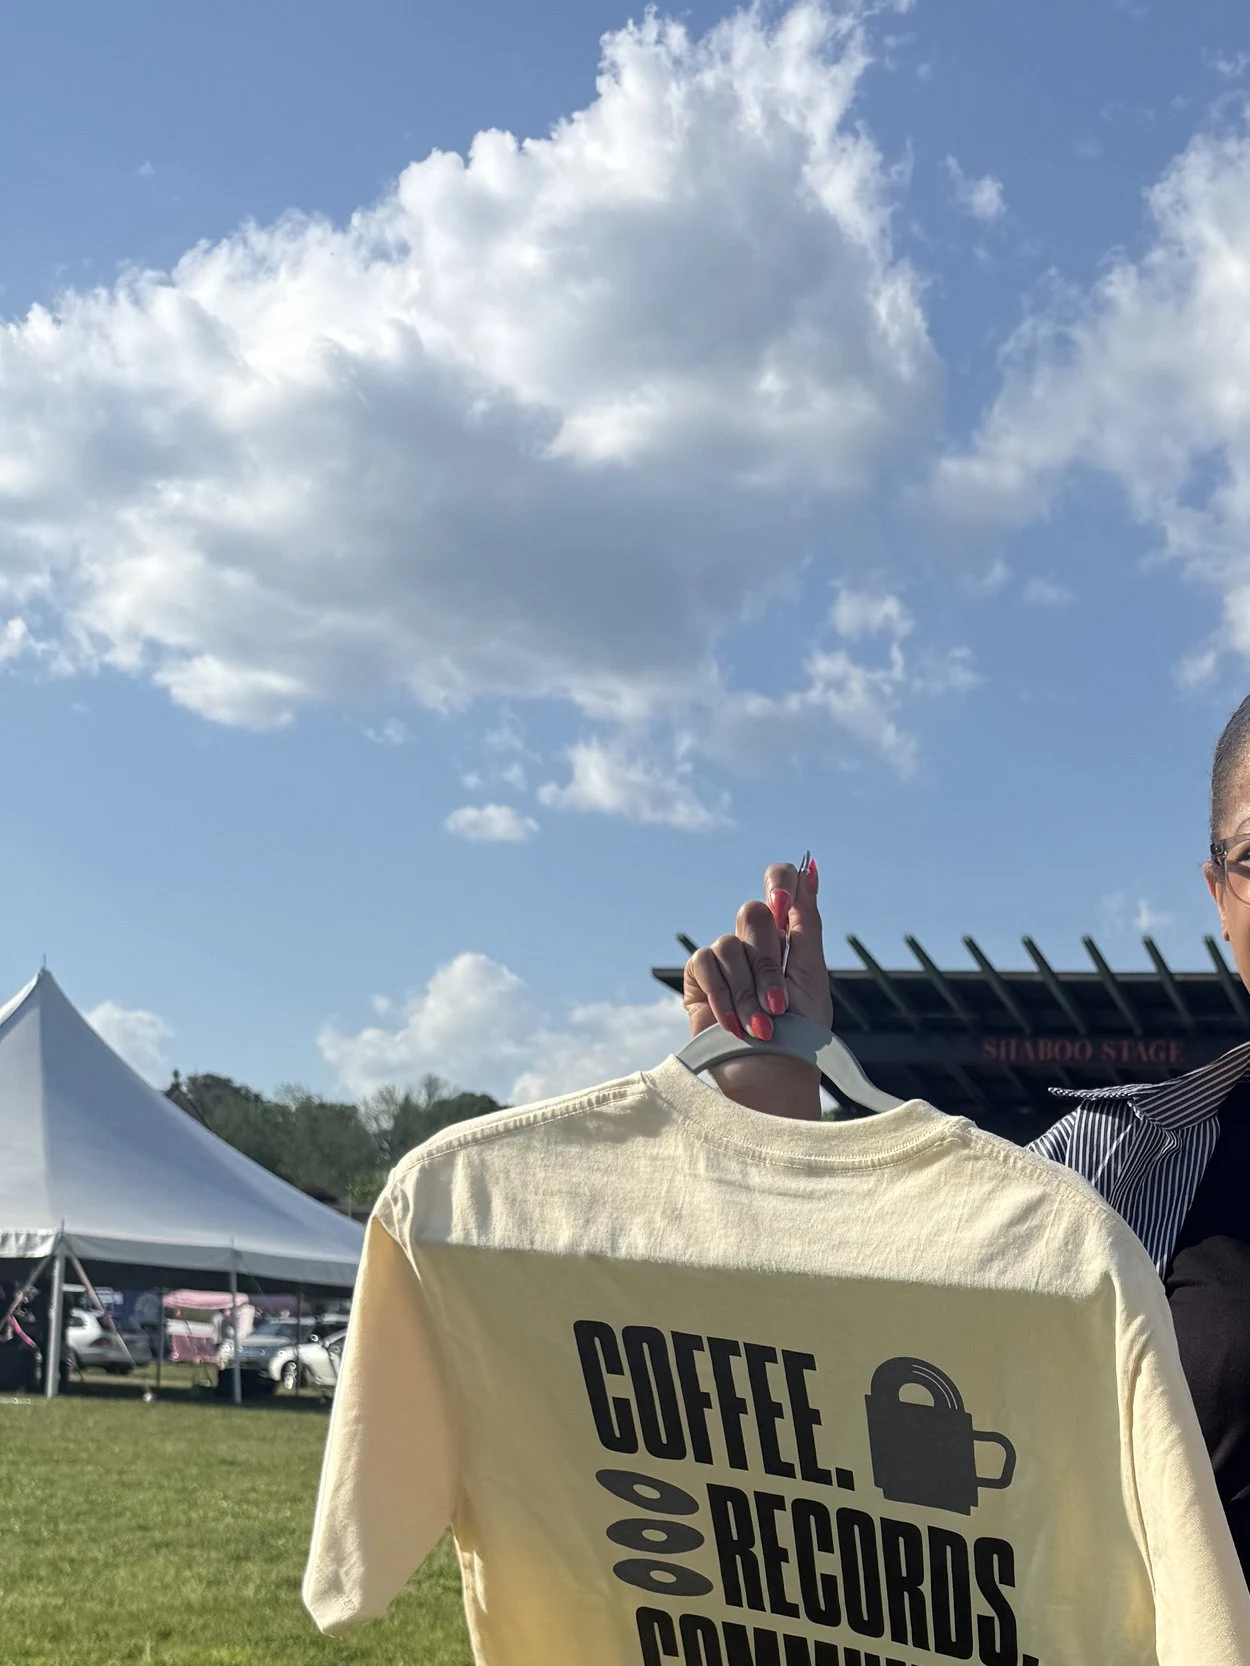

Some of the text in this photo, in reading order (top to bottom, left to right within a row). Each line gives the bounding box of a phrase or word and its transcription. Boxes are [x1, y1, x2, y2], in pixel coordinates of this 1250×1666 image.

[982, 1037, 1184, 1063] SHABOO STAGE
[573, 1320, 855, 1491] COFFEE.
